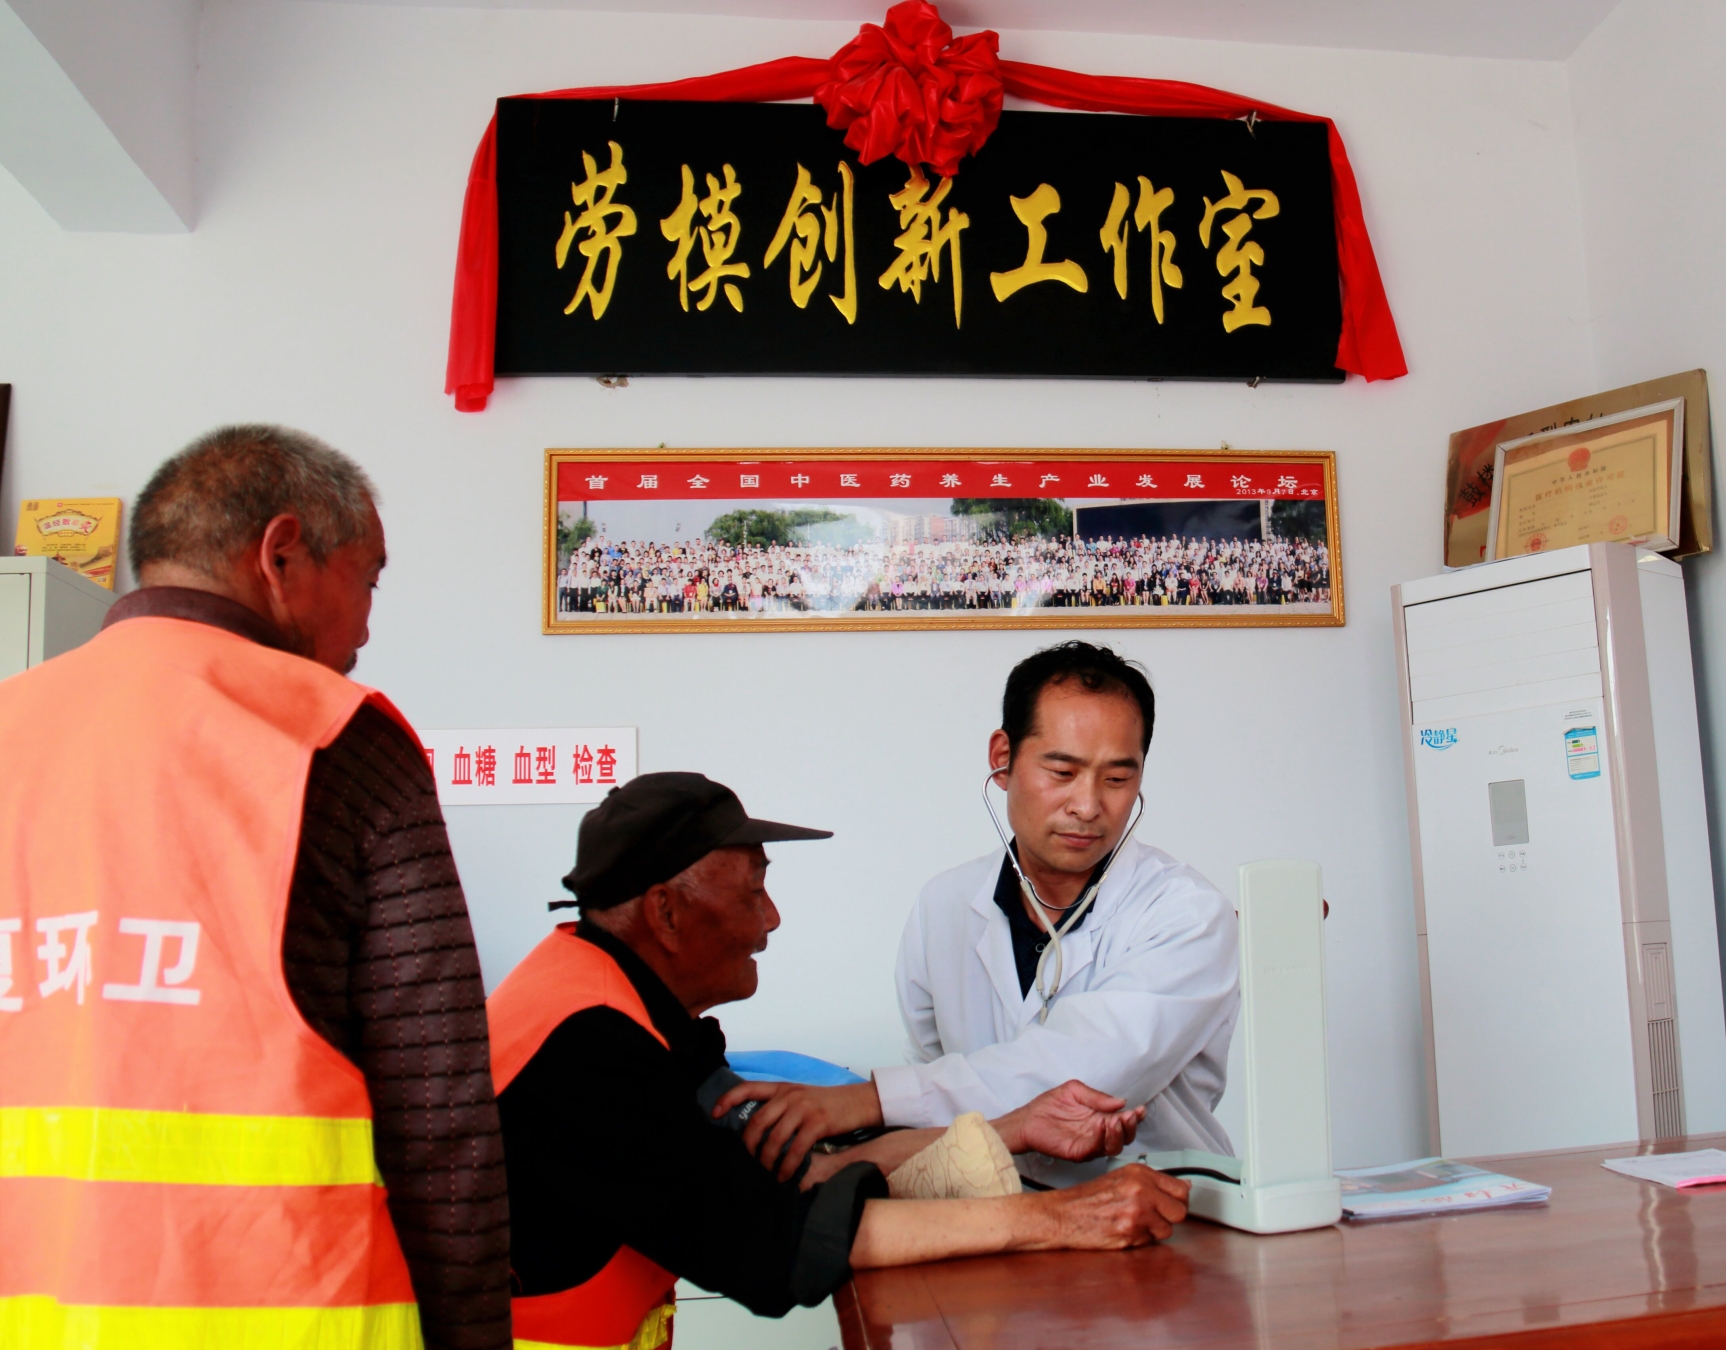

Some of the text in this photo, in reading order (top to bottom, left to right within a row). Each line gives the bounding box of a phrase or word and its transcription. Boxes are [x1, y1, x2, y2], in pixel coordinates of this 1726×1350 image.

[555, 141, 1281, 333] 劳模创新工作室
[585, 472, 1299, 490] 首届全国中医药养生产业发展论坛
[1420, 728, 1457, 748] 冷静星
[451, 745, 497, 786] 血糖
[511, 745, 557, 785] 血型
[572, 744, 617, 785] 检查
